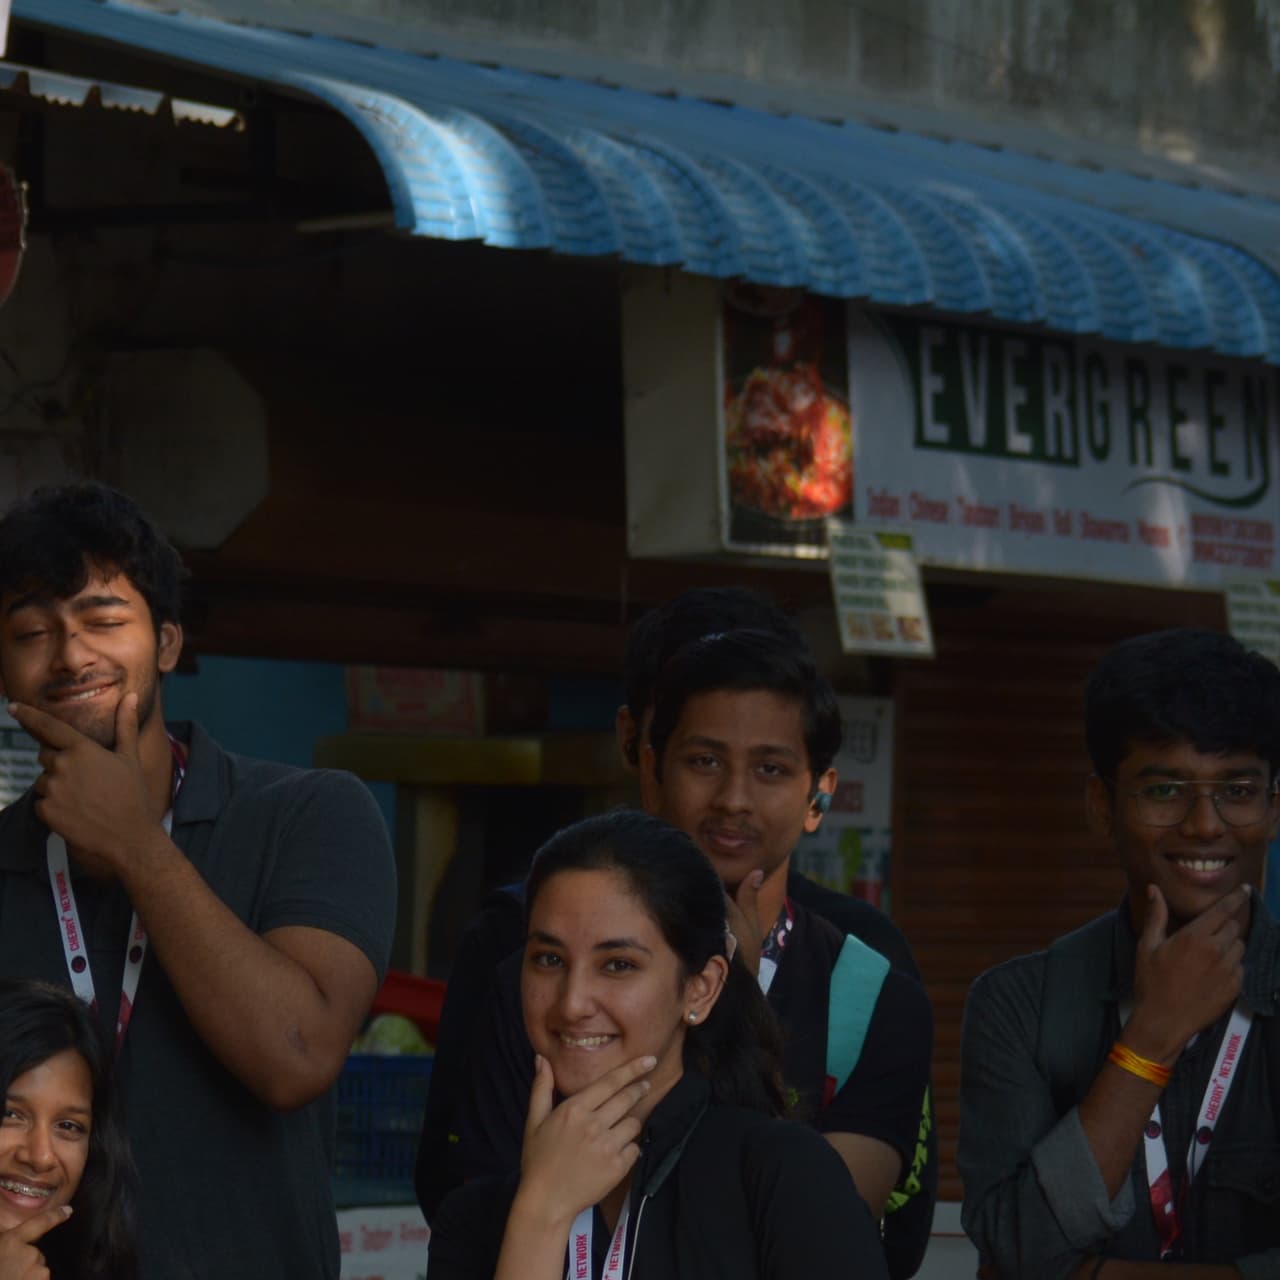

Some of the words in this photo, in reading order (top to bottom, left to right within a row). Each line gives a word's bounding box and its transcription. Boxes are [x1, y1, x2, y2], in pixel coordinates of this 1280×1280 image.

[919, 324, 1270, 483] EVERGREEN
[55, 872, 72, 912] NETWORK
[1218, 1033, 1242, 1080] NETWORK
[576, 1234, 588, 1279] NETWORK
